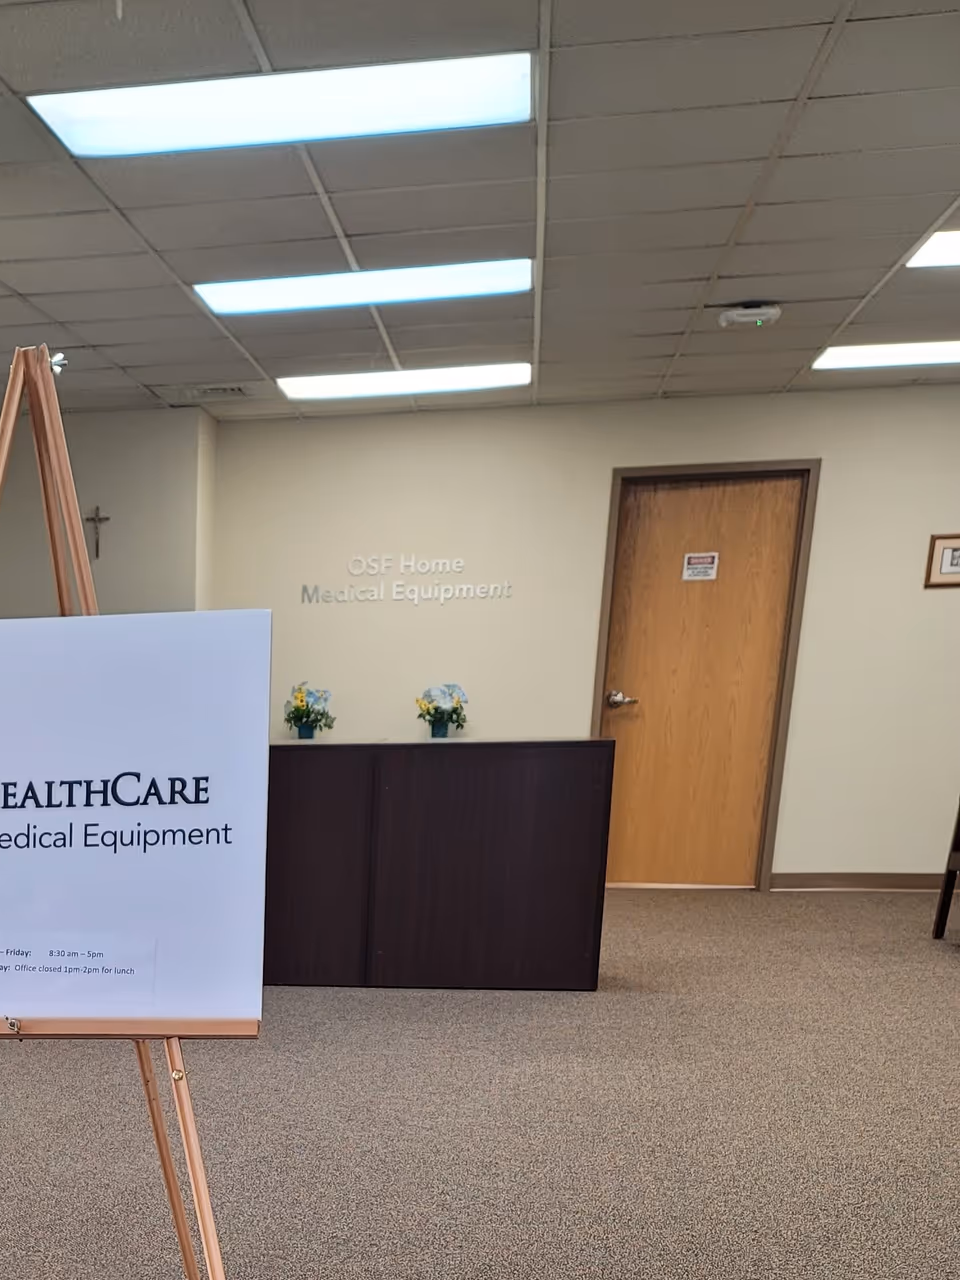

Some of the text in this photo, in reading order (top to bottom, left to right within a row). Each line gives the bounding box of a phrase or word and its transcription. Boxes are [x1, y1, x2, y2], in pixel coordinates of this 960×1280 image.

[348, 554, 465, 576] OSF Home
[301, 579, 512, 606] Medical Equipment
[83, 822, 232, 854] Equipment
[5, 948, 32, 958] Friday:
[48, 949, 66, 957] 8:30
[87, 950, 104, 959] 5pm
[14, 964, 37, 972] Office
[38, 965, 62, 973] closed
[63, 965, 100, 975] 1pm-2pm
[101, 966, 112, 974] for
[114, 966, 135, 975] lunch
